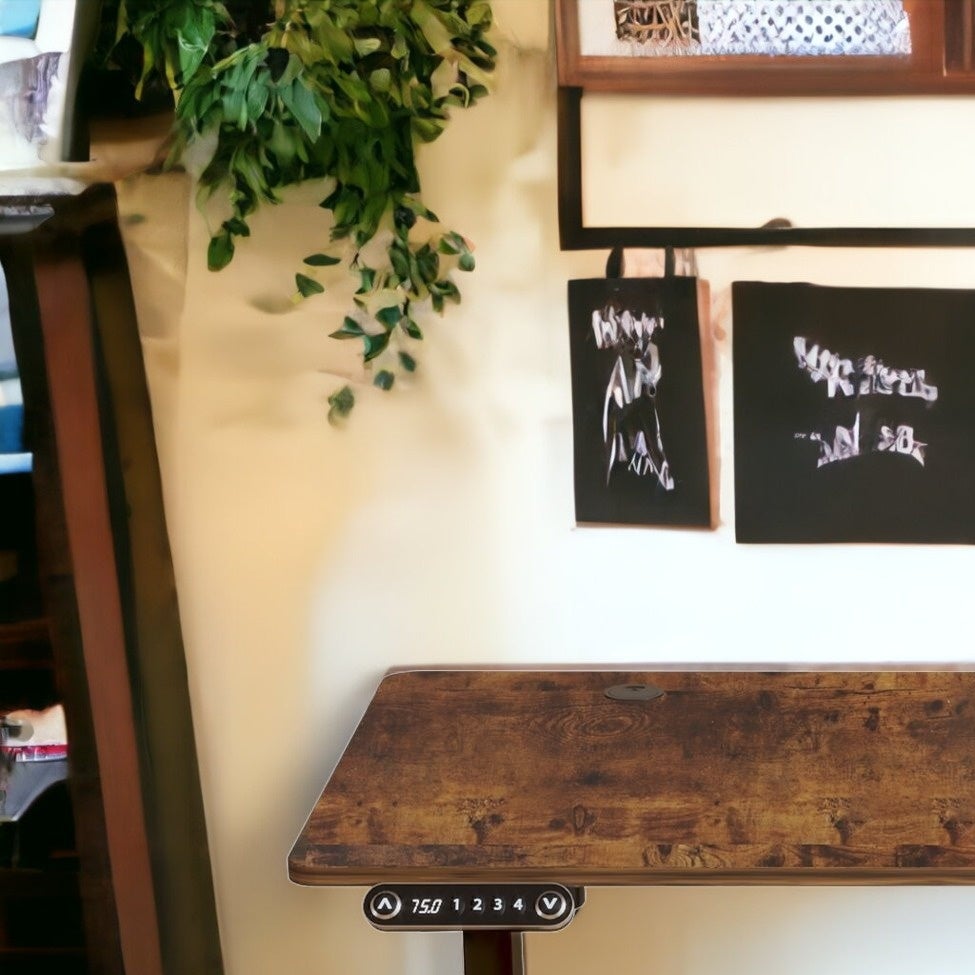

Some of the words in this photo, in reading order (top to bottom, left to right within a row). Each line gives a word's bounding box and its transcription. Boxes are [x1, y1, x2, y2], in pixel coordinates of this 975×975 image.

[411, 898, 443, 914] 75.0
[453, 898, 460, 911] 1
[473, 898, 482, 911] 2
[493, 898, 503, 911] 3
[513, 898, 524, 911] 4
